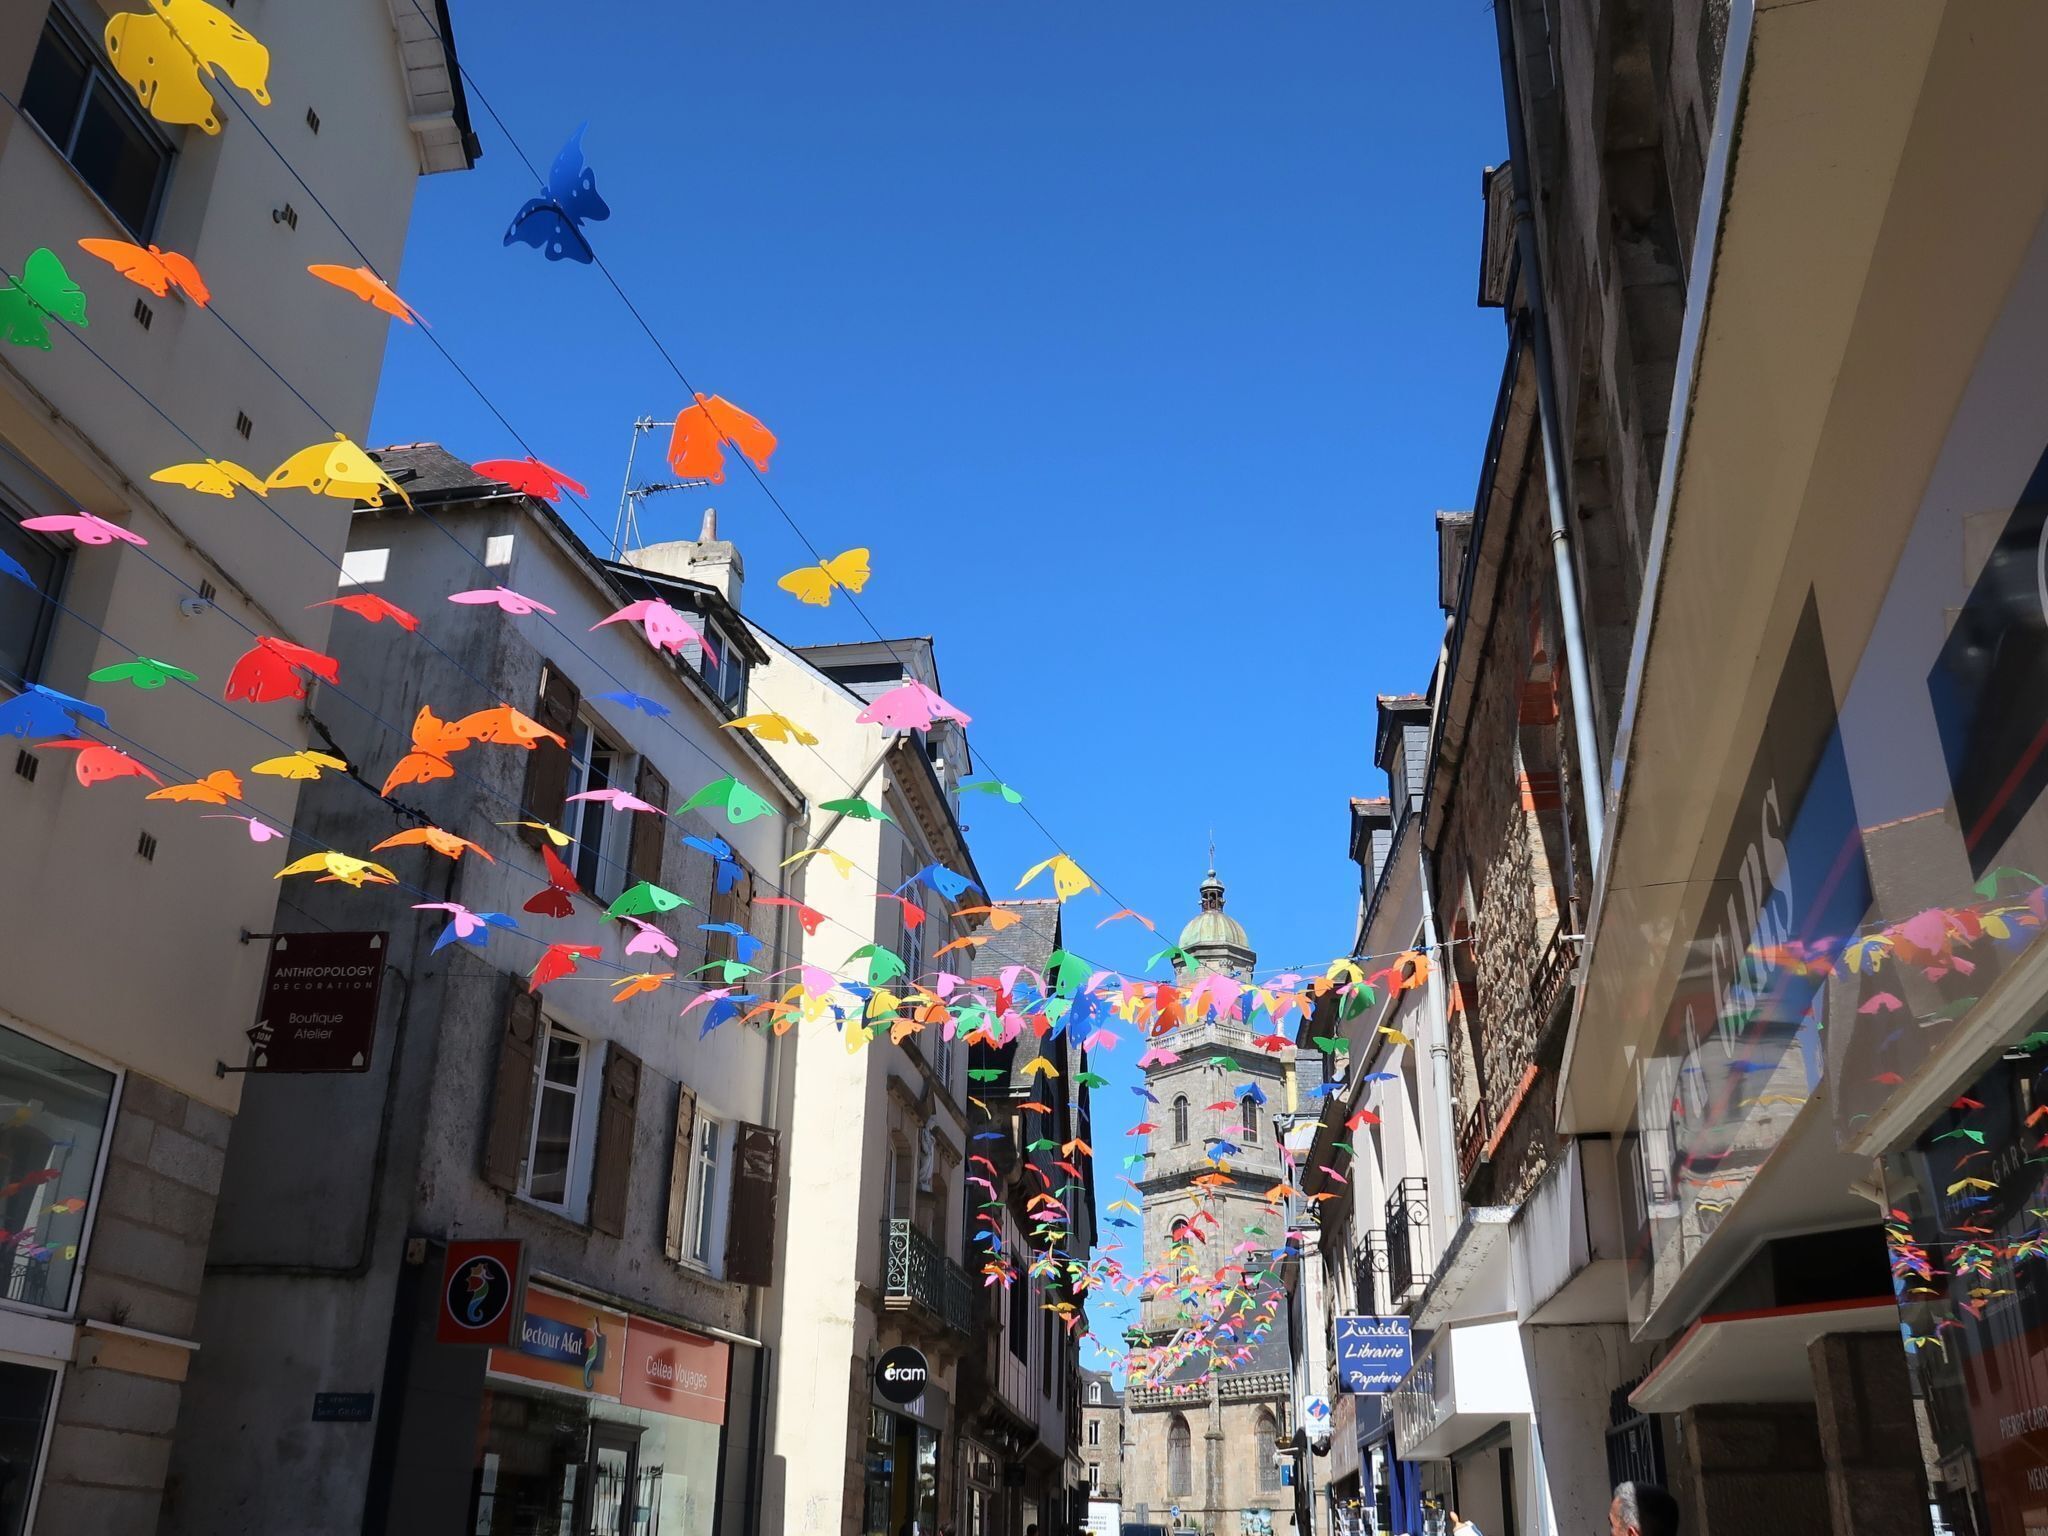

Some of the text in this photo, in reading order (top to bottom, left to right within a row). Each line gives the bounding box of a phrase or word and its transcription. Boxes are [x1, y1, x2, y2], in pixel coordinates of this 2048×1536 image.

[274, 966, 375, 978] ANTHROPOLOGY
[272, 981, 373, 991] DECORATION
[288, 1012, 344, 1025] Boutique
[294, 1028, 333, 1040] Atelier
[522, 1320, 582, 1356] lectour Afat
[1344, 1342, 1404, 1359] Librairie
[645, 1354, 708, 1389] Celtea Voyages
[884, 1361, 926, 1381] éram
[1349, 1370, 1402, 1390] Papeterie
[1999, 1411, 2028, 1440] PIERRE
